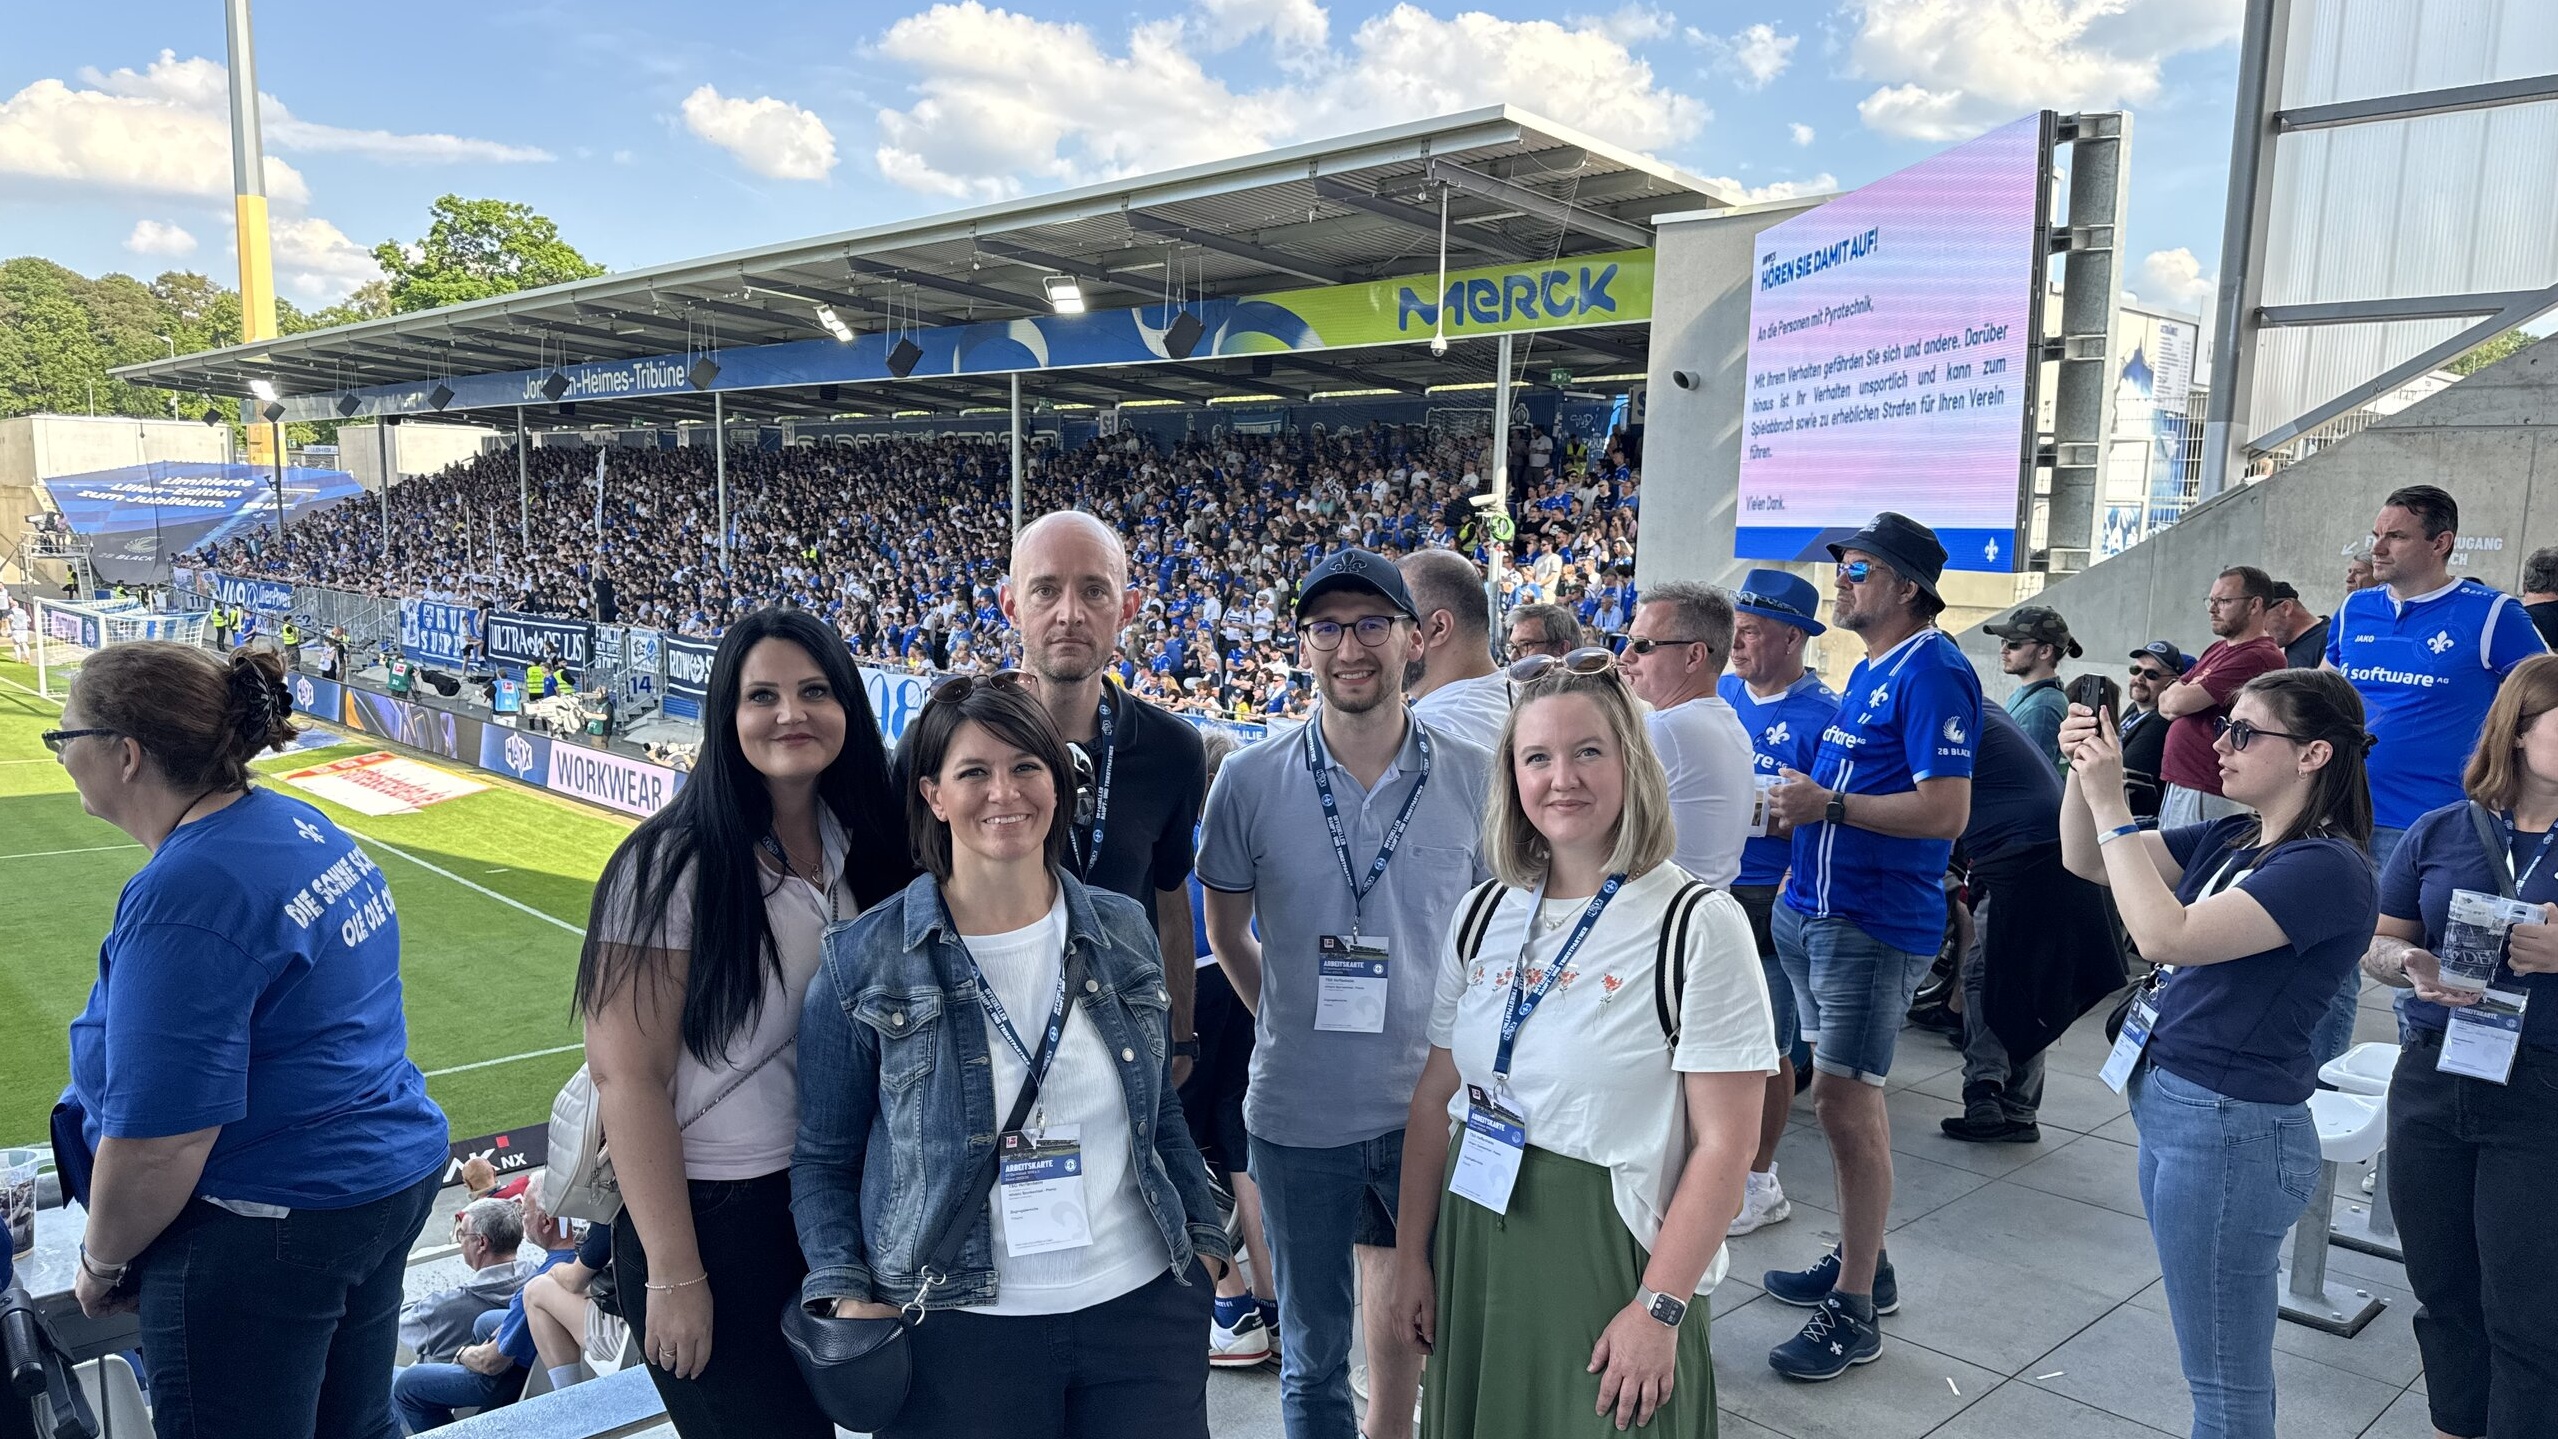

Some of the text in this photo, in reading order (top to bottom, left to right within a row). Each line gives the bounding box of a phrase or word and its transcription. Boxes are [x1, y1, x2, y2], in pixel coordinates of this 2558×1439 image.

[1761, 260, 1795, 291] HÖREN
[1796, 253, 1813, 279] SIE
[1814, 239, 1850, 273] DAMIT
[1850, 226, 1878, 260] AUF!
[1400, 263, 1618, 331] MERCK
[1757, 295, 1874, 342] An die Personen mit Pyrotechnik,
[1754, 322, 2009, 390] Mit Ihrem Verhalten gefährden Sie sich und andere. Darüber
[1752, 357, 2006, 413] hinaus ist Ihr Verhalten unsportlich und kann zum
[1751, 385, 2004, 439] Spielabbruch sowie zu erheblichen Strafen für Ihren Verein
[1750, 444, 1773, 460] führen.
[110, 483, 242, 498] Lilien-Edition
[160, 477, 255, 488] Limitierte
[77, 490, 227, 509] zum Jubiläum.
[1746, 495, 1785, 511] Vielen Dank.
[115, 554, 155, 563] BLACK
[2354, 634, 2375, 643] JAKO
[630, 675, 651, 695] 14
[2350, 666, 2434, 687] software
[556, 750, 662, 812] WORKWEAR
[284, 888, 326, 930] DIE
[311, 856, 361, 905] SONNE
[1559, 926, 1589, 967] TRIKOTPARTNER
[983, 987, 1008, 1022] OFFIZIELLER
[998, 1023, 1031, 1066] TRIKOTPARTNER
[502, 1152, 527, 1170] NX
[1005, 1160, 1054, 1173] ARBEITSKARTE
